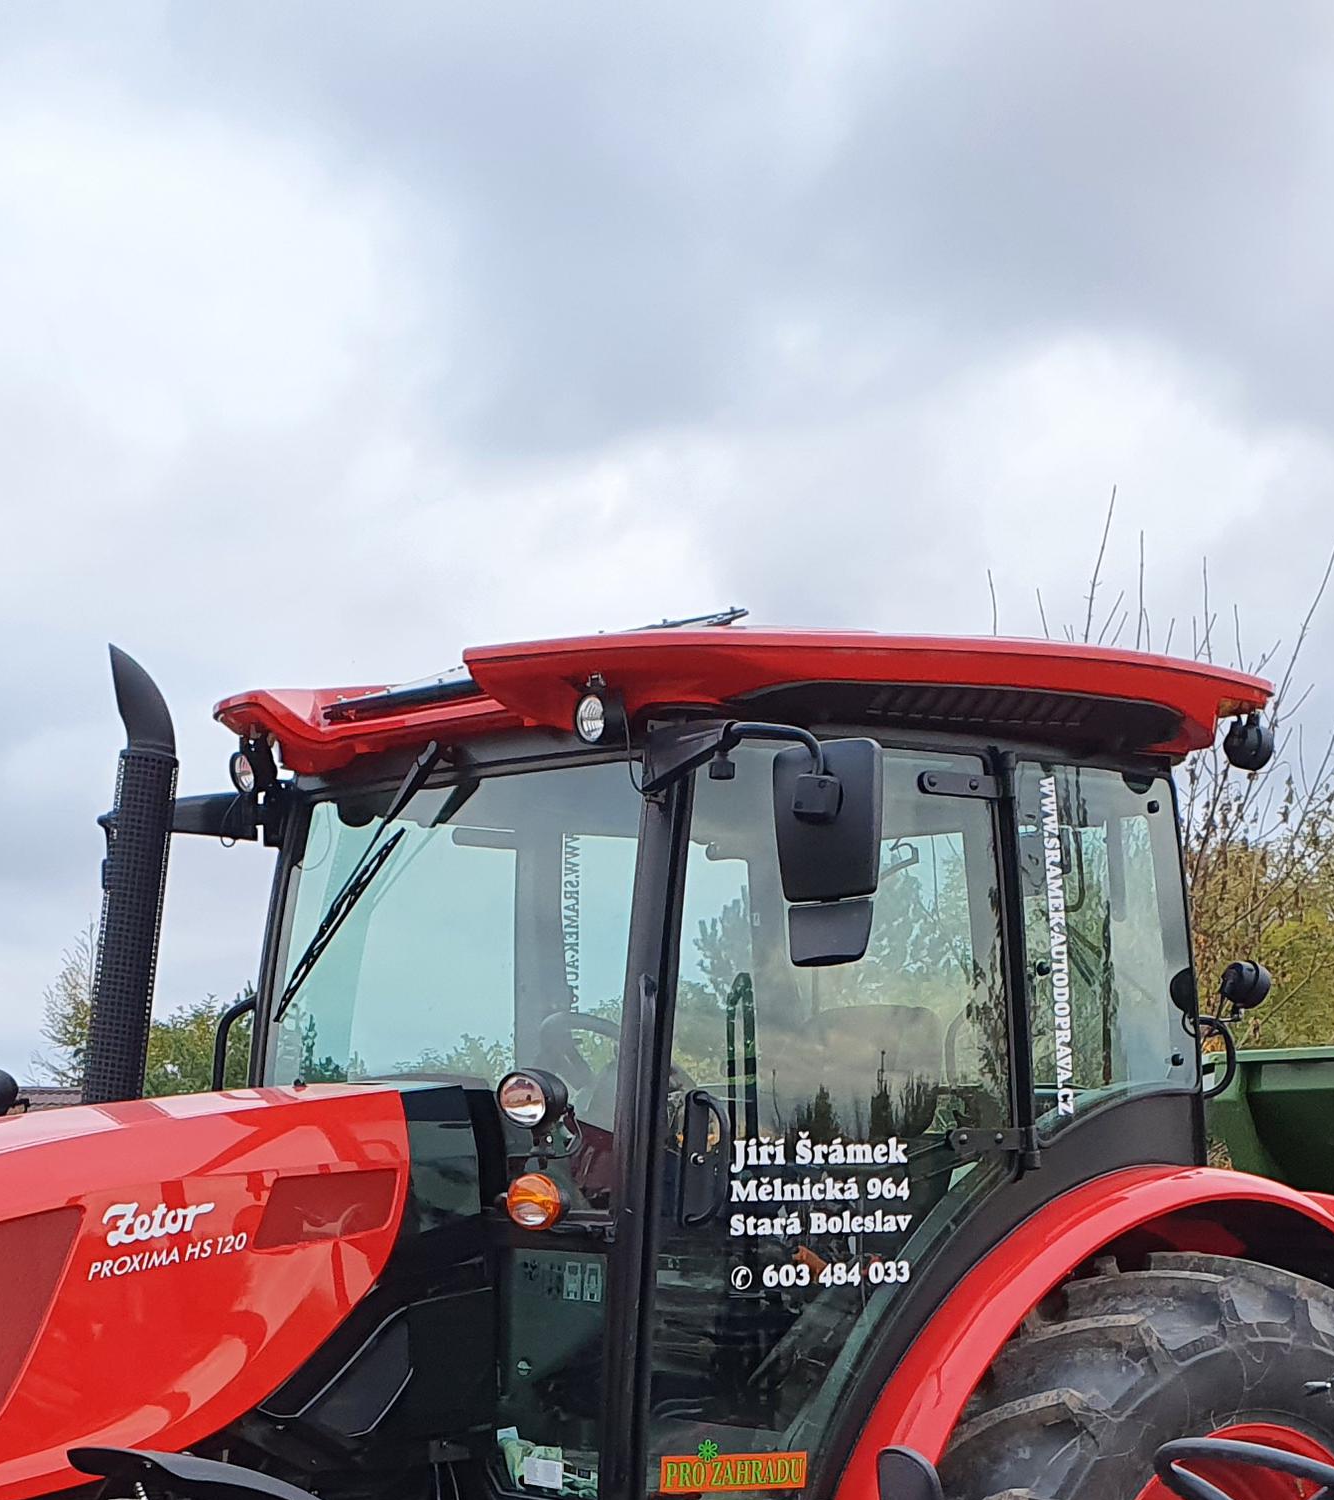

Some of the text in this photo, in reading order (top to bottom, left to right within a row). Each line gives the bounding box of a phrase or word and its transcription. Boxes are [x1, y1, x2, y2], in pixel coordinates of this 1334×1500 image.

[730, 1131, 908, 1173] Jiří Šrámek
[730, 1177, 910, 1202] Mělnická 964
[102, 1202, 215, 1247] Zetor
[730, 1210, 913, 1236] Stará Boleslav
[88, 1232, 247, 1281] PROXIMA HS 120
[762, 1260, 910, 1288] 603 484 033
[665, 1458, 804, 1488] PRO ZAHRADU
